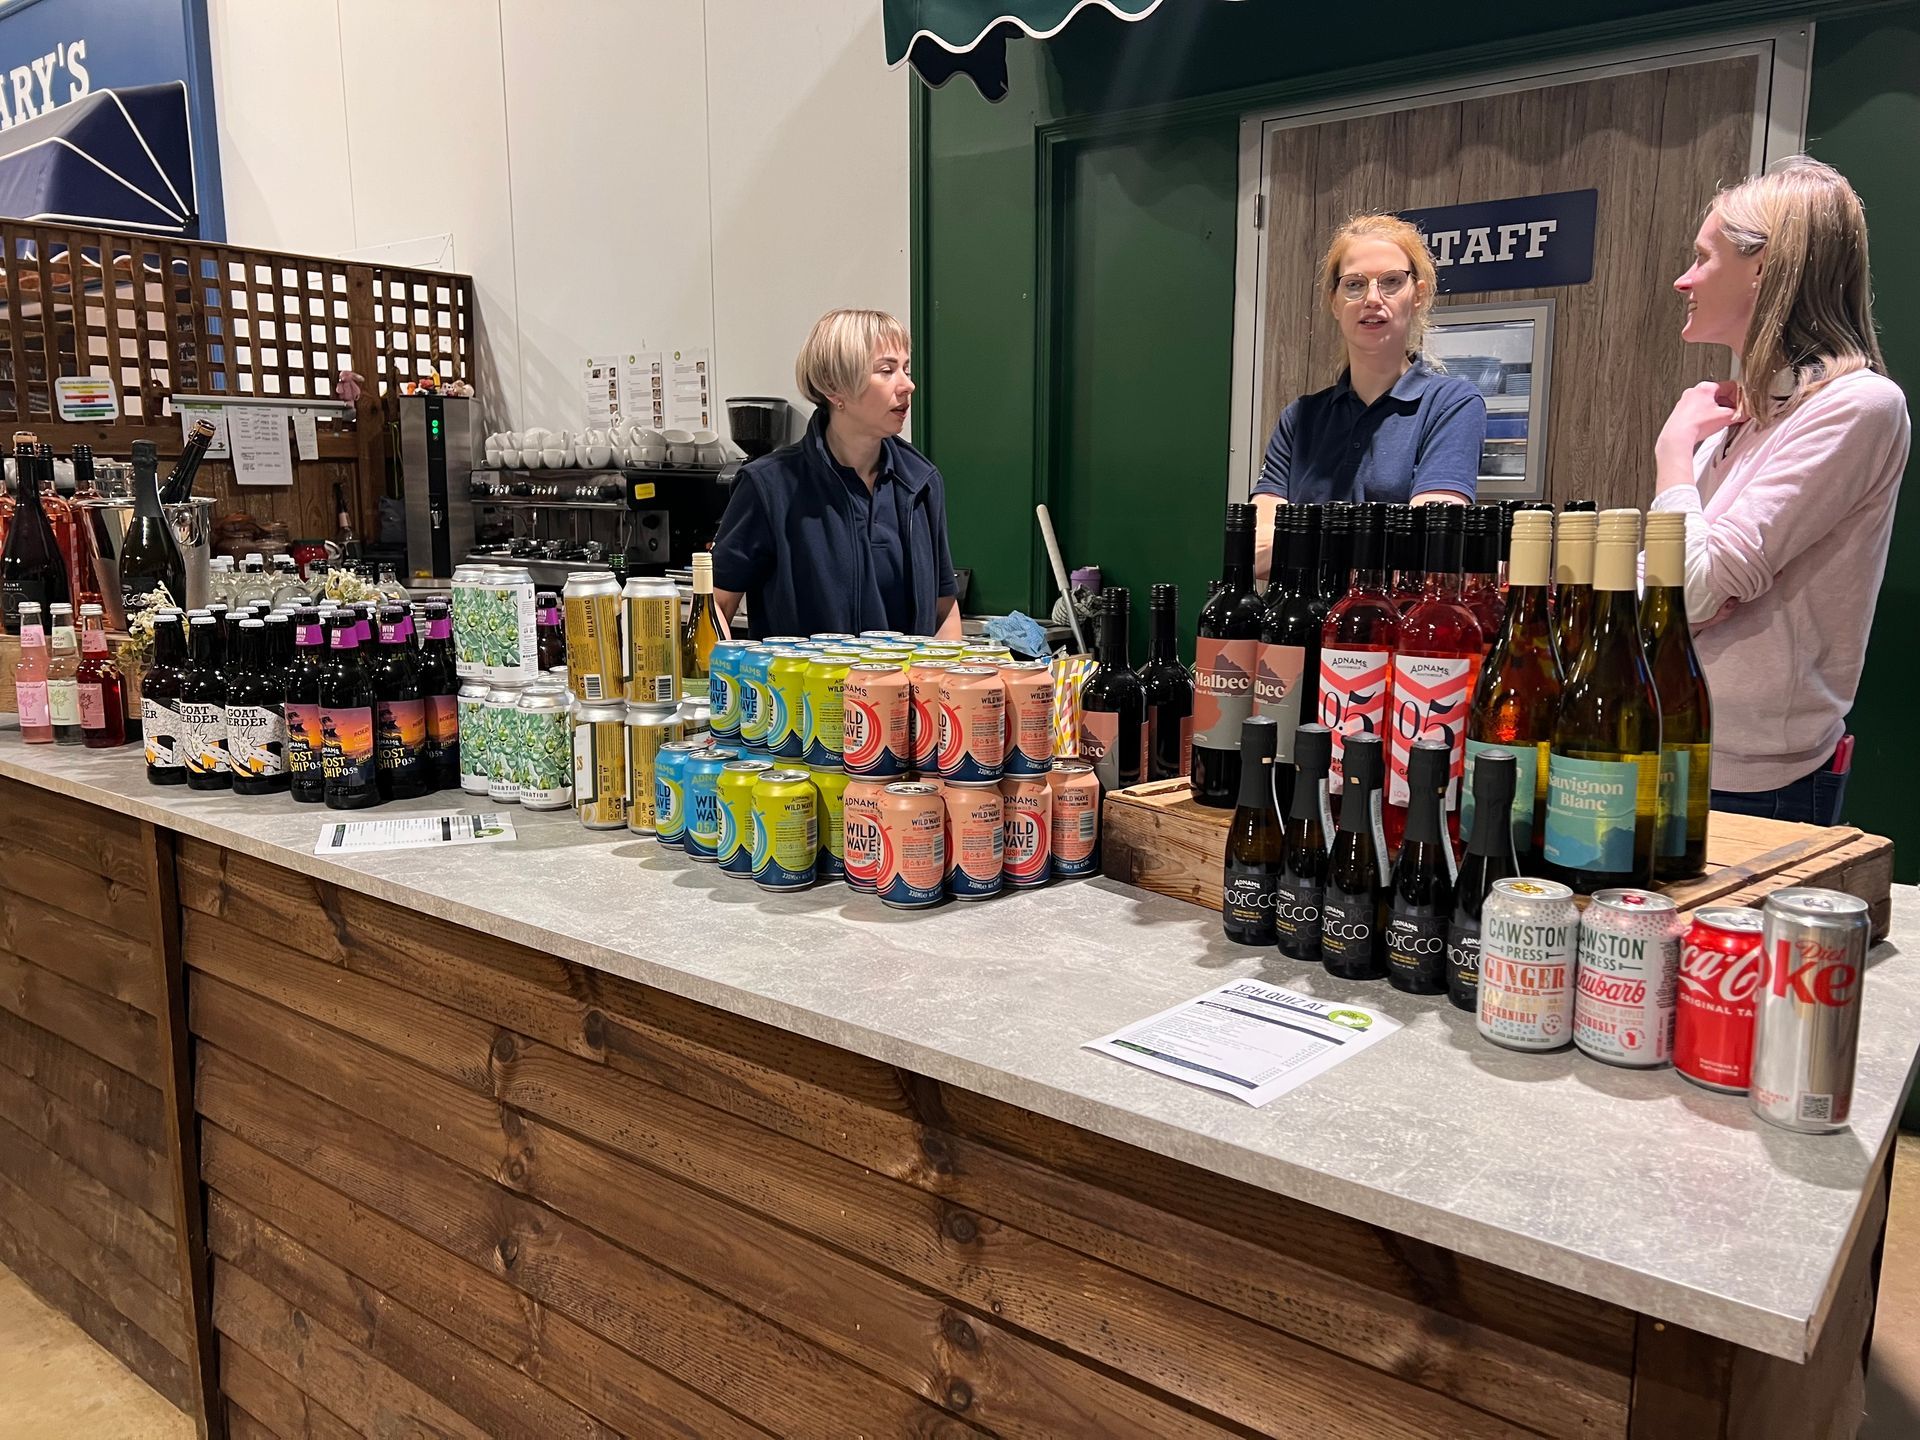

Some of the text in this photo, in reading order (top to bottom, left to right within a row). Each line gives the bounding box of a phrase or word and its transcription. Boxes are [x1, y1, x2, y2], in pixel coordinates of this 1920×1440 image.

[1424, 220, 1557, 267] TAFF
[1332, 656, 1368, 668] ADNAMS
[1410, 663, 1449, 676] ADNAMS
[181, 705, 210, 715] GOAT
[227, 708, 258, 718] GOAT
[181, 714, 219, 724] ERDER
[290, 760, 310, 773] SHIP
[324, 766, 342, 778] SHIP
[656, 783, 671, 797] ILD
[1003, 796, 1038, 807] DNAMS
[1560, 792, 1607, 811] Blanc
[912, 818, 928, 826] WILD
[972, 811, 988, 819] WILD
[846, 821, 877, 839] WILD
[846, 836, 876, 852] WAVE
[1234, 879, 1260, 889] ADNAMS
[1276, 899, 1318, 921] SECCO
[1489, 918, 1568, 947] CAWSTON
[1578, 925, 1645, 961] AWSTON
[1796, 940, 1846, 961] Diet
[1506, 945, 1543, 961] PRESS
[1585, 952, 1616, 971] PRESS
[1485, 957, 1565, 990] GINGER
[1504, 985, 1541, 997] BEER
[1579, 968, 1647, 1004] hubarb
[1681, 992, 1732, 1016] ORIGINAL
